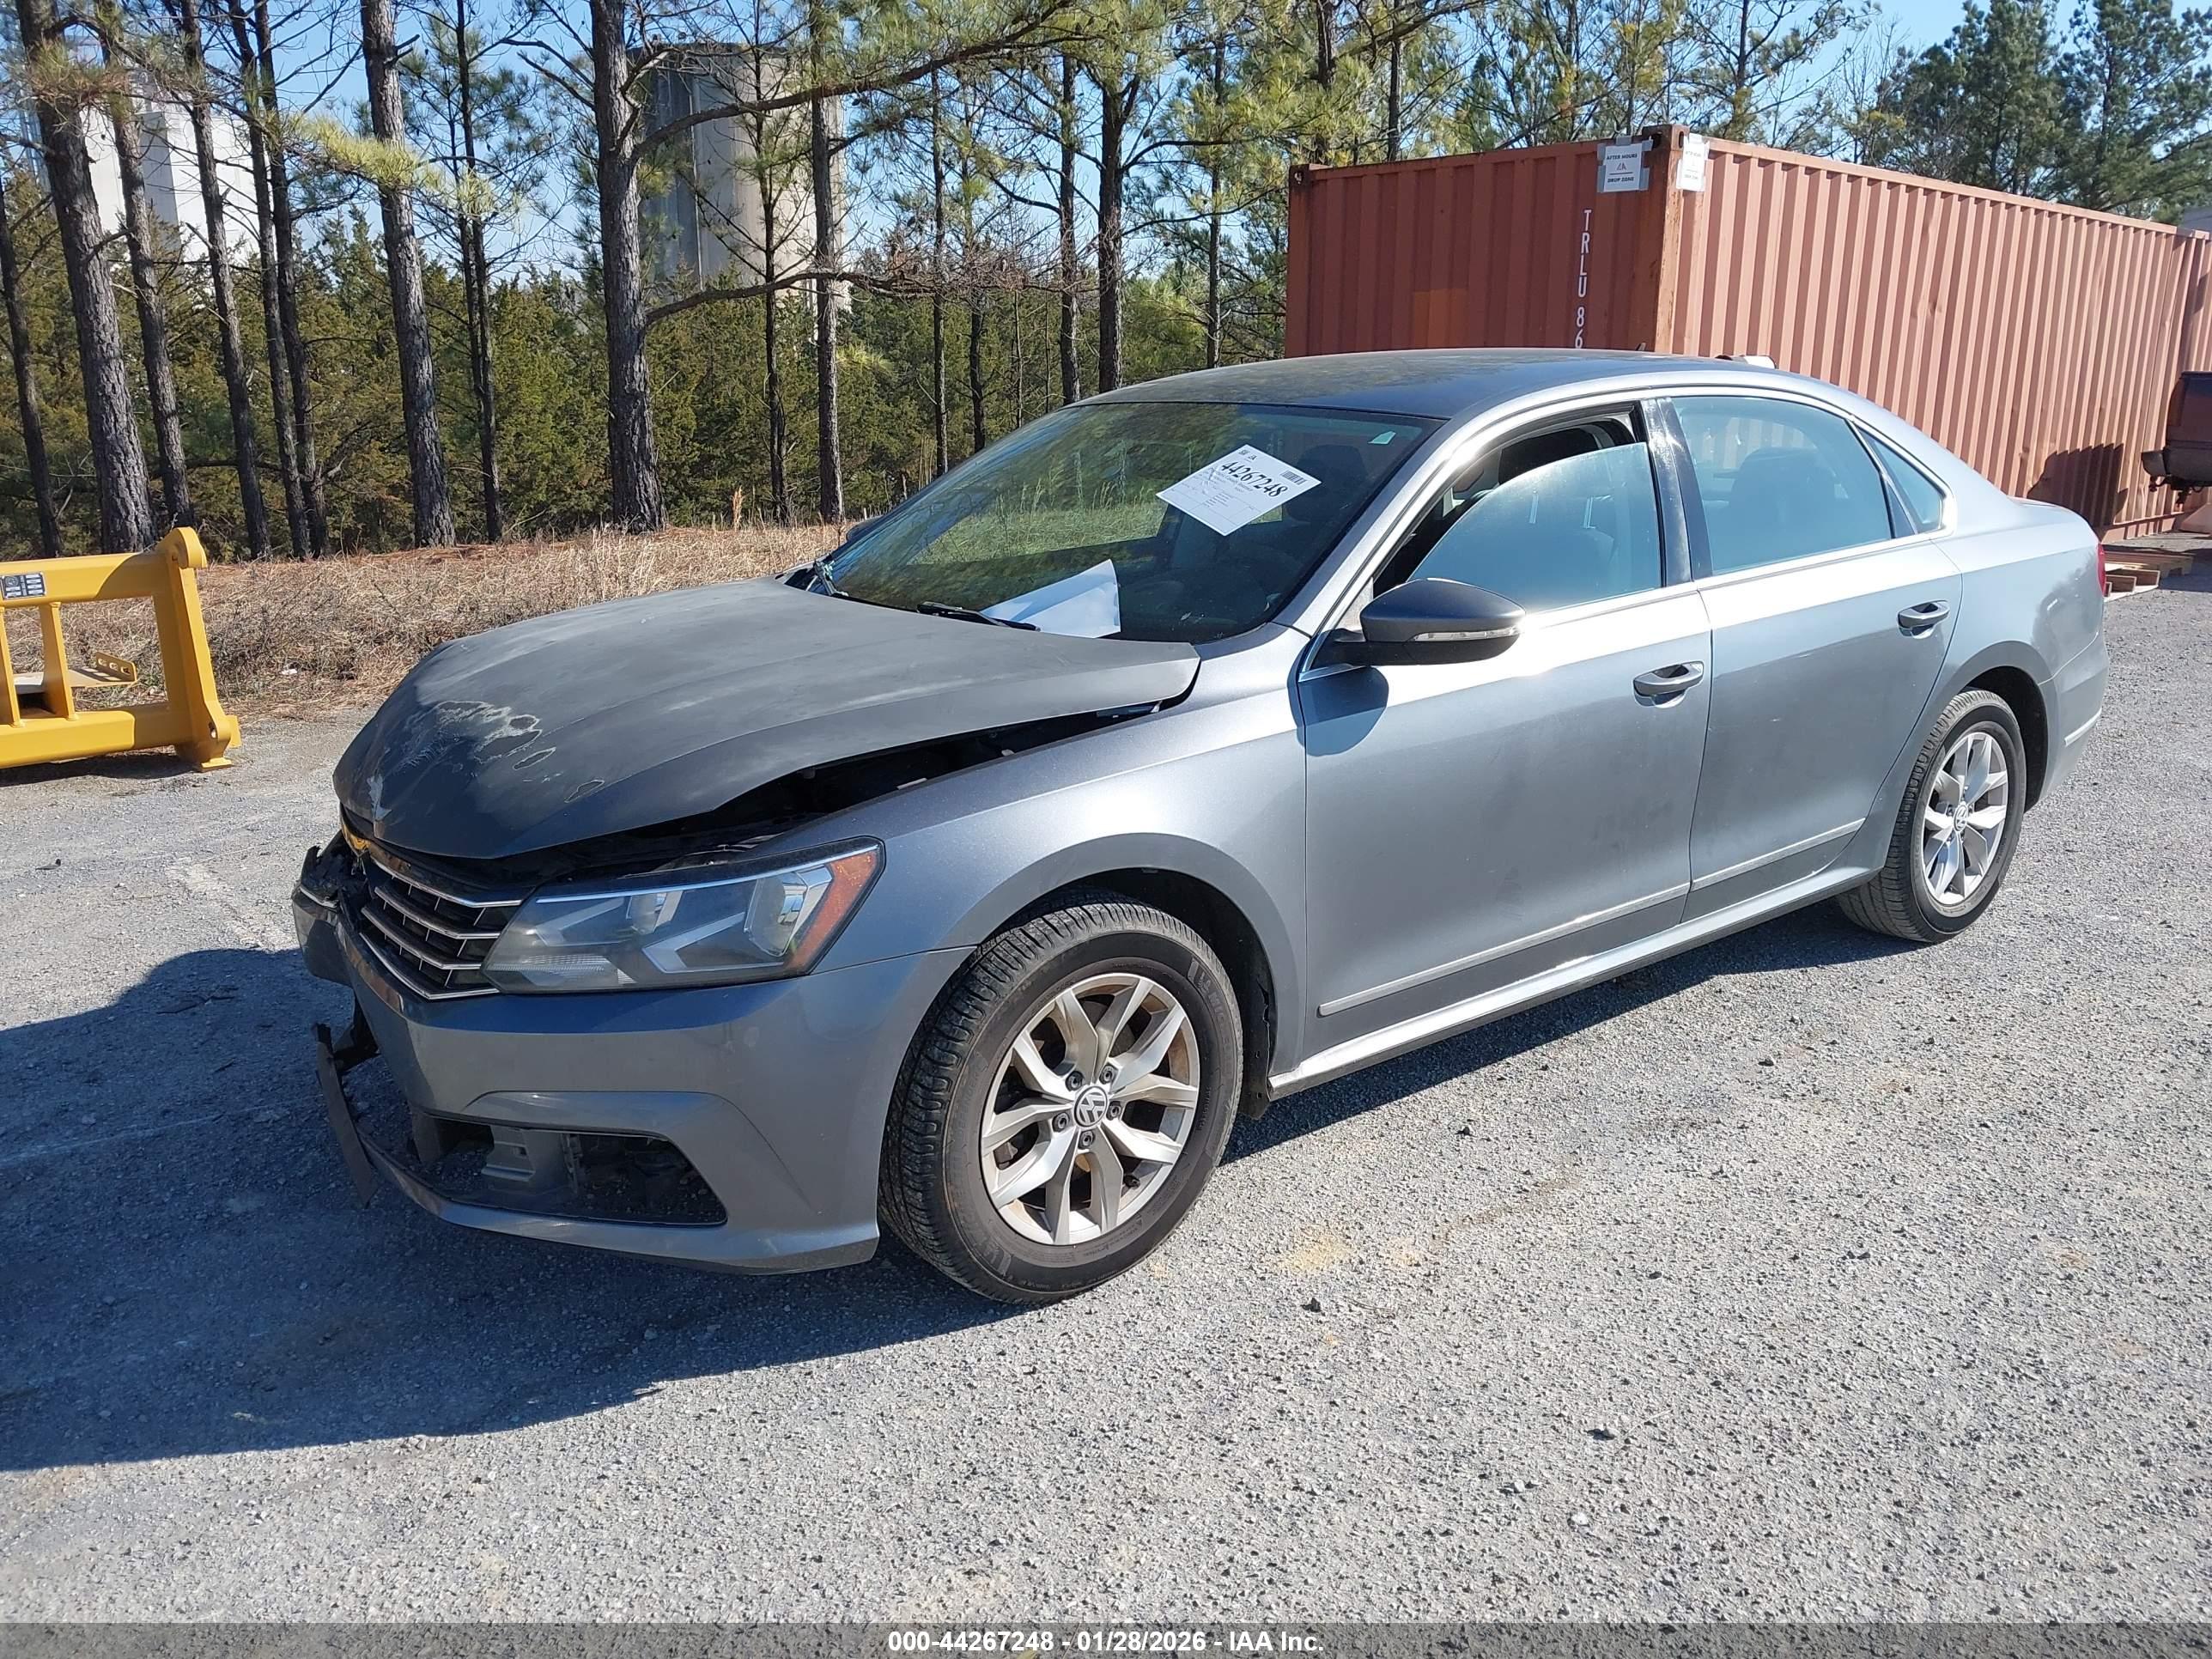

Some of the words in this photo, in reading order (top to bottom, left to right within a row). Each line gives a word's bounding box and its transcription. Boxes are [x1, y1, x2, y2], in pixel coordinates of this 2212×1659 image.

[1577, 210, 1592, 297] TRLU
[1575, 307, 1585, 349] 86
[1221, 461, 1288, 497] 44267248
